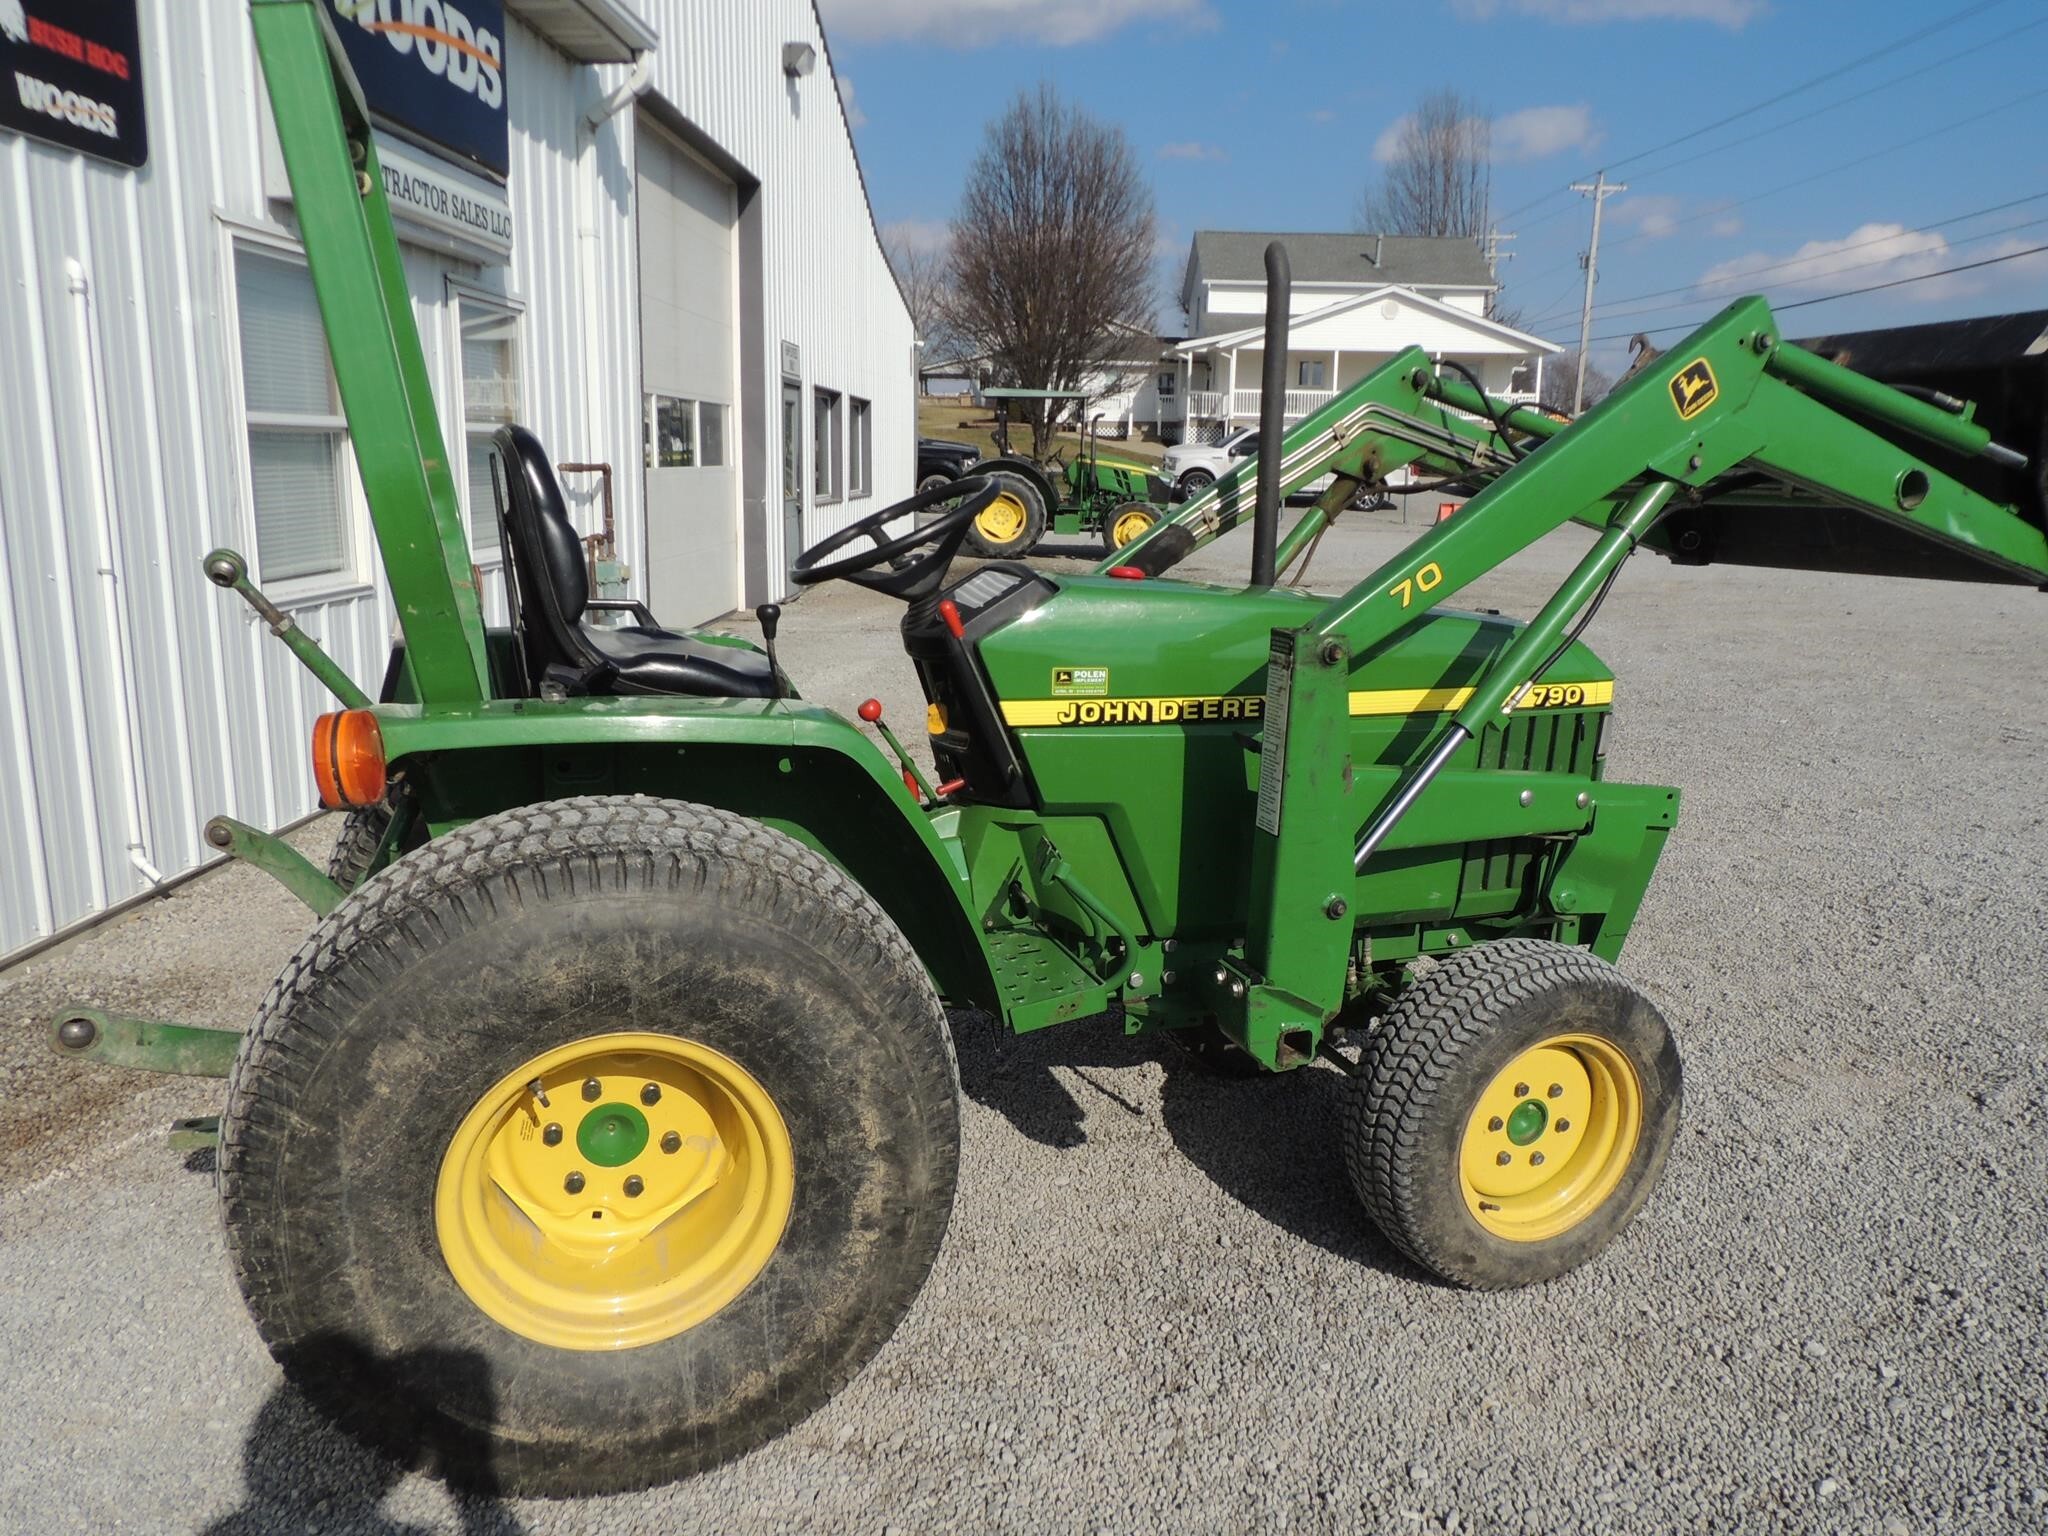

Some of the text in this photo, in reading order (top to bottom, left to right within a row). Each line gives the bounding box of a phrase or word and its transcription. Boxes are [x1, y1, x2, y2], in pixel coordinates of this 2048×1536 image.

[86, 39, 131, 80] HOG
[14, 70, 120, 139] WOODS
[381, 165, 511, 239] TRACTOR SALES LLC
[1387, 561, 1443, 609] 70
[1074, 670, 1106, 678] POLEN
[1057, 698, 1264, 724] JOHN DEERE
[1532, 685, 1584, 707] 790
